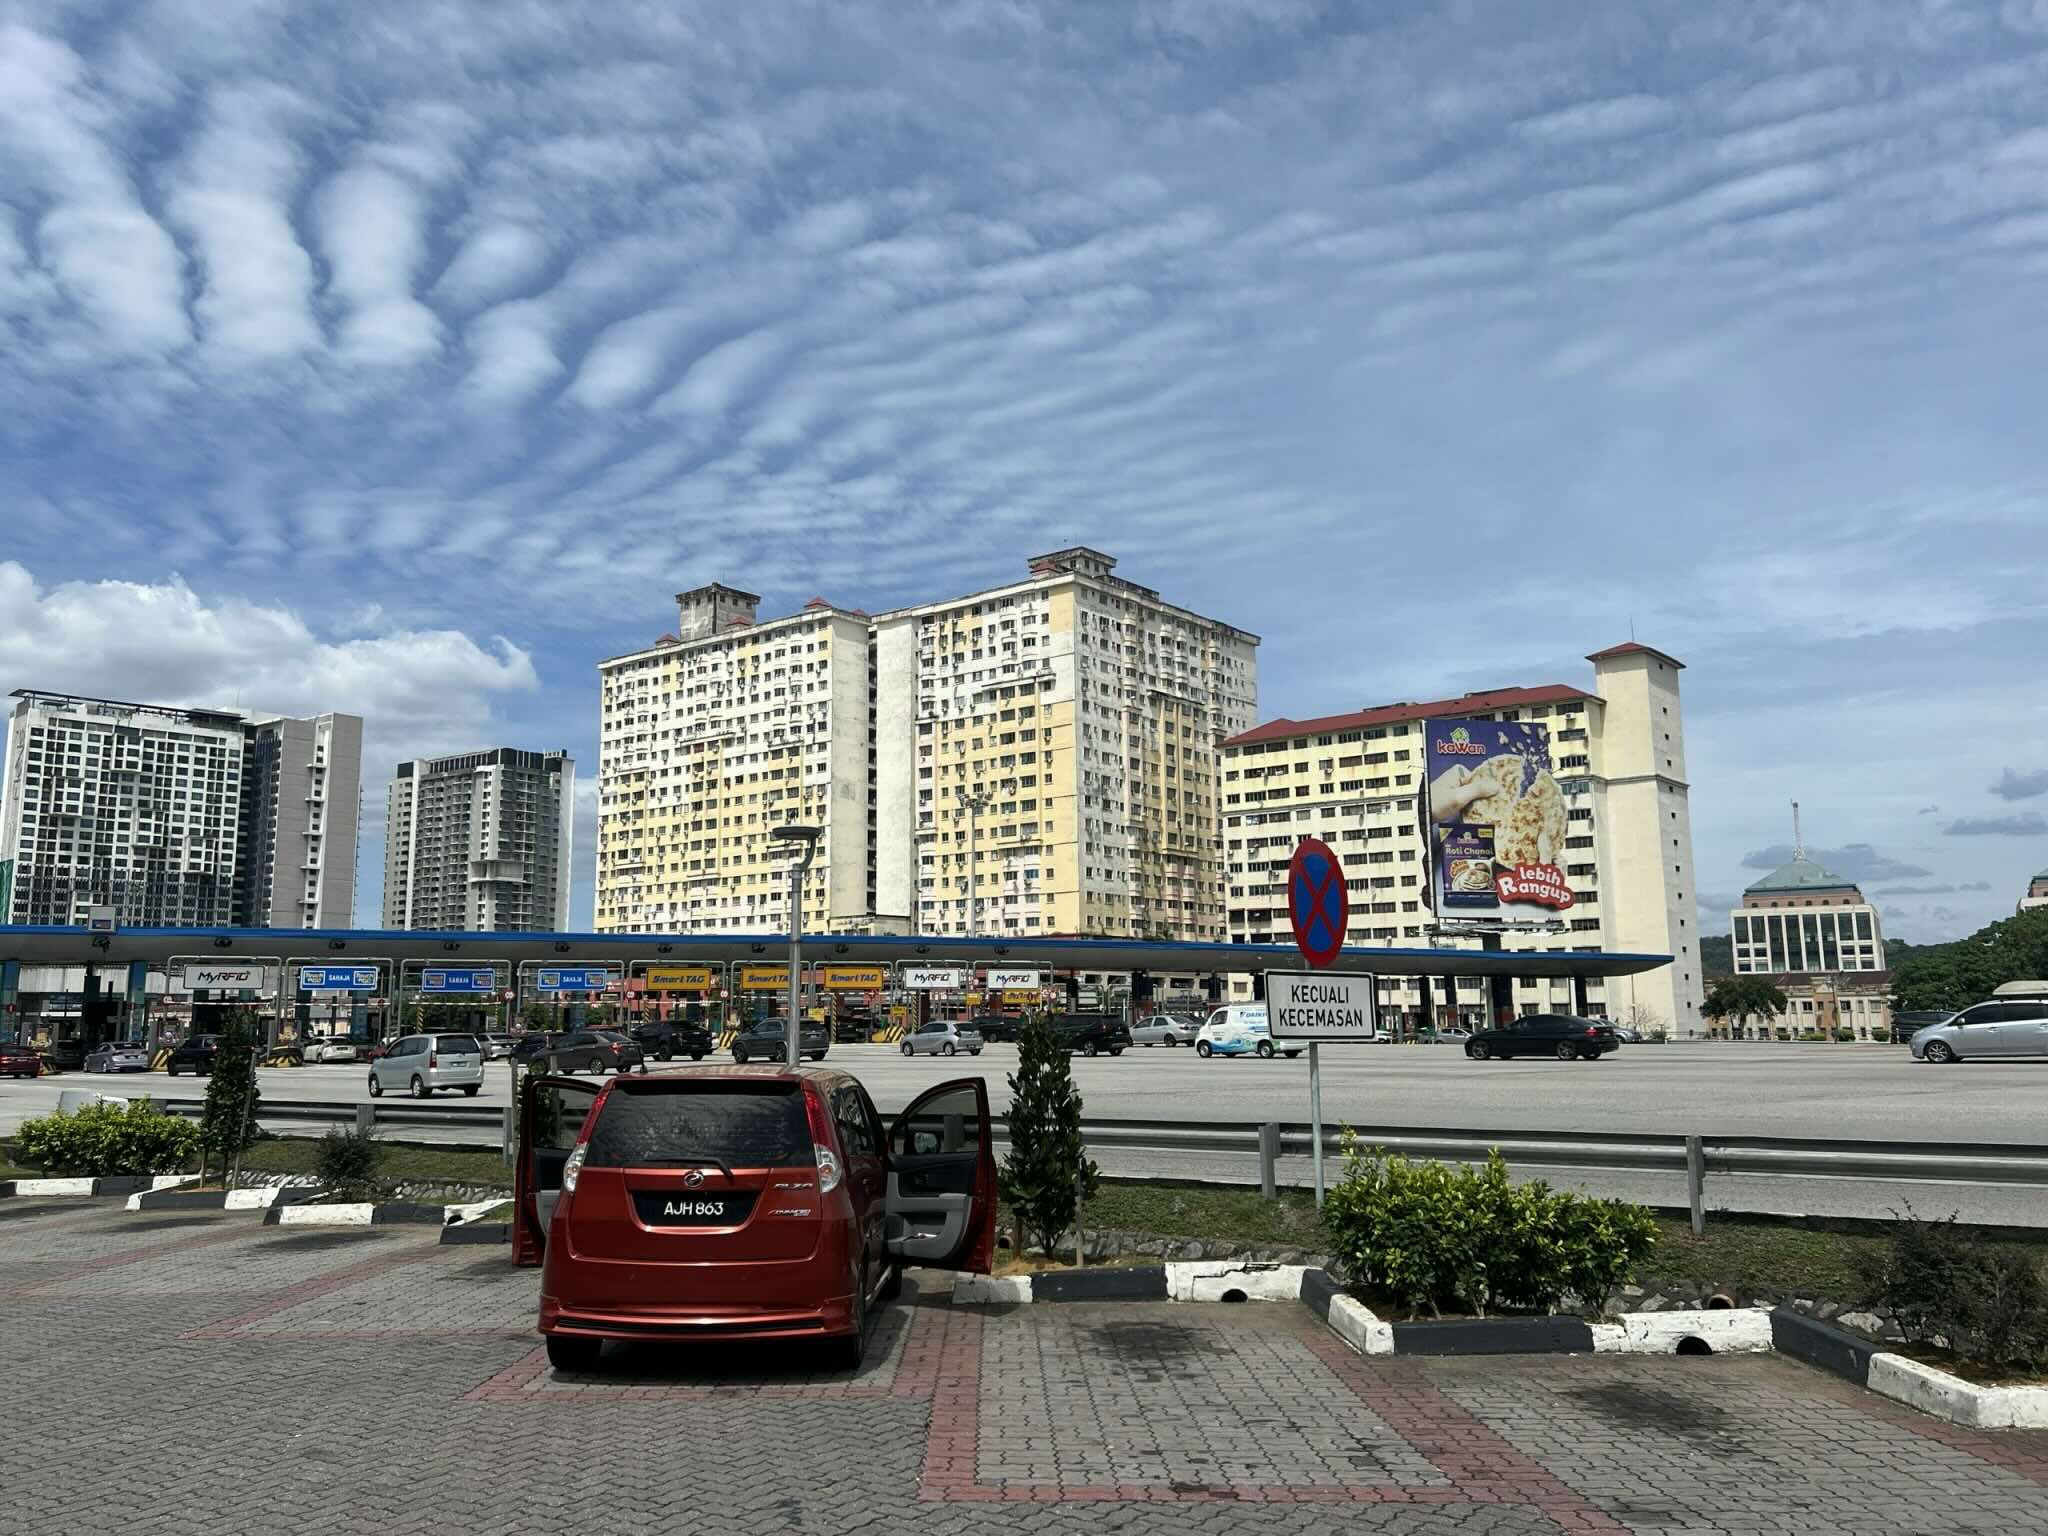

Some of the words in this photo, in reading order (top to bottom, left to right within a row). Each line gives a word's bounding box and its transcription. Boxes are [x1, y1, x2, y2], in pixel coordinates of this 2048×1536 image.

[1445, 846, 1463, 855] Roti
[1520, 867, 1561, 885] lebih
[1498, 876, 1570, 904] Rangup
[1291, 984, 1349, 1004] KECUALI
[1279, 1007, 1363, 1027] KECEMASAN
[664, 1201, 693, 1216] AJH
[695, 1201, 724, 1216] 863
